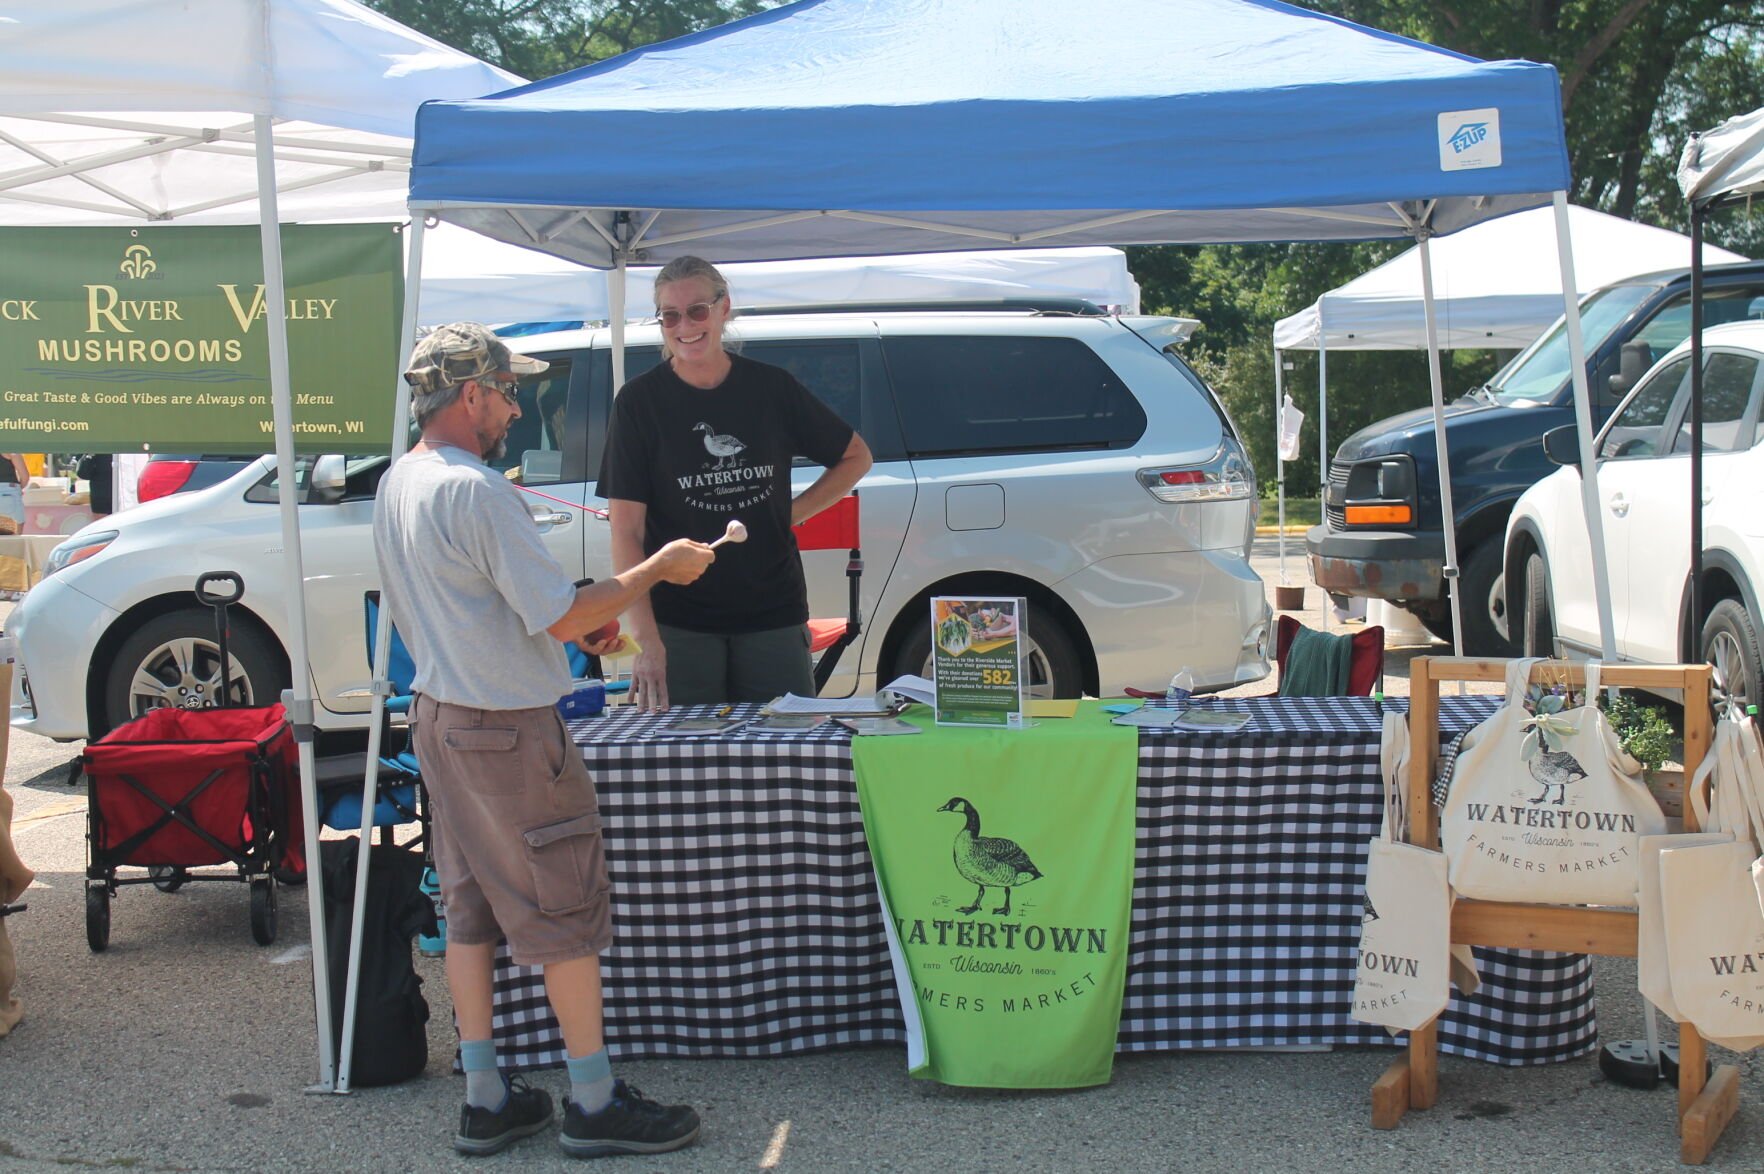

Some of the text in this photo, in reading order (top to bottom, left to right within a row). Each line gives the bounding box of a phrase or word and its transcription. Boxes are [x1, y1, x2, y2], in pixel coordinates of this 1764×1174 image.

[82, 284, 184, 333] RIVER
[216, 283, 339, 334] VALEY
[38, 339, 242, 362] MUSHROOMS
[4, 391, 39, 403] Great
[43, 392, 77, 403] Taste
[80, 392, 91, 404] &
[94, 392, 128, 404] Good
[132, 393, 167, 405] Vibes
[171, 396, 193, 405] are
[196, 393, 245, 408] Always
[249, 395, 266, 405] on
[296, 393, 334, 405] Menu
[259, 421, 342, 434] Wrtown,
[345, 421, 364, 433] WI
[685, 484, 774, 512] FARMERS MARKET
[983, 669, 1011, 685] 582
[1467, 803, 1637, 833] WATERTOWN
[1521, 832, 1575, 848] Wisconsin
[1466, 834, 1629, 873] FARMERS MARKET
[950, 955, 1023, 976] Wisconsin
[1003, 972, 1096, 1013] MARKET
